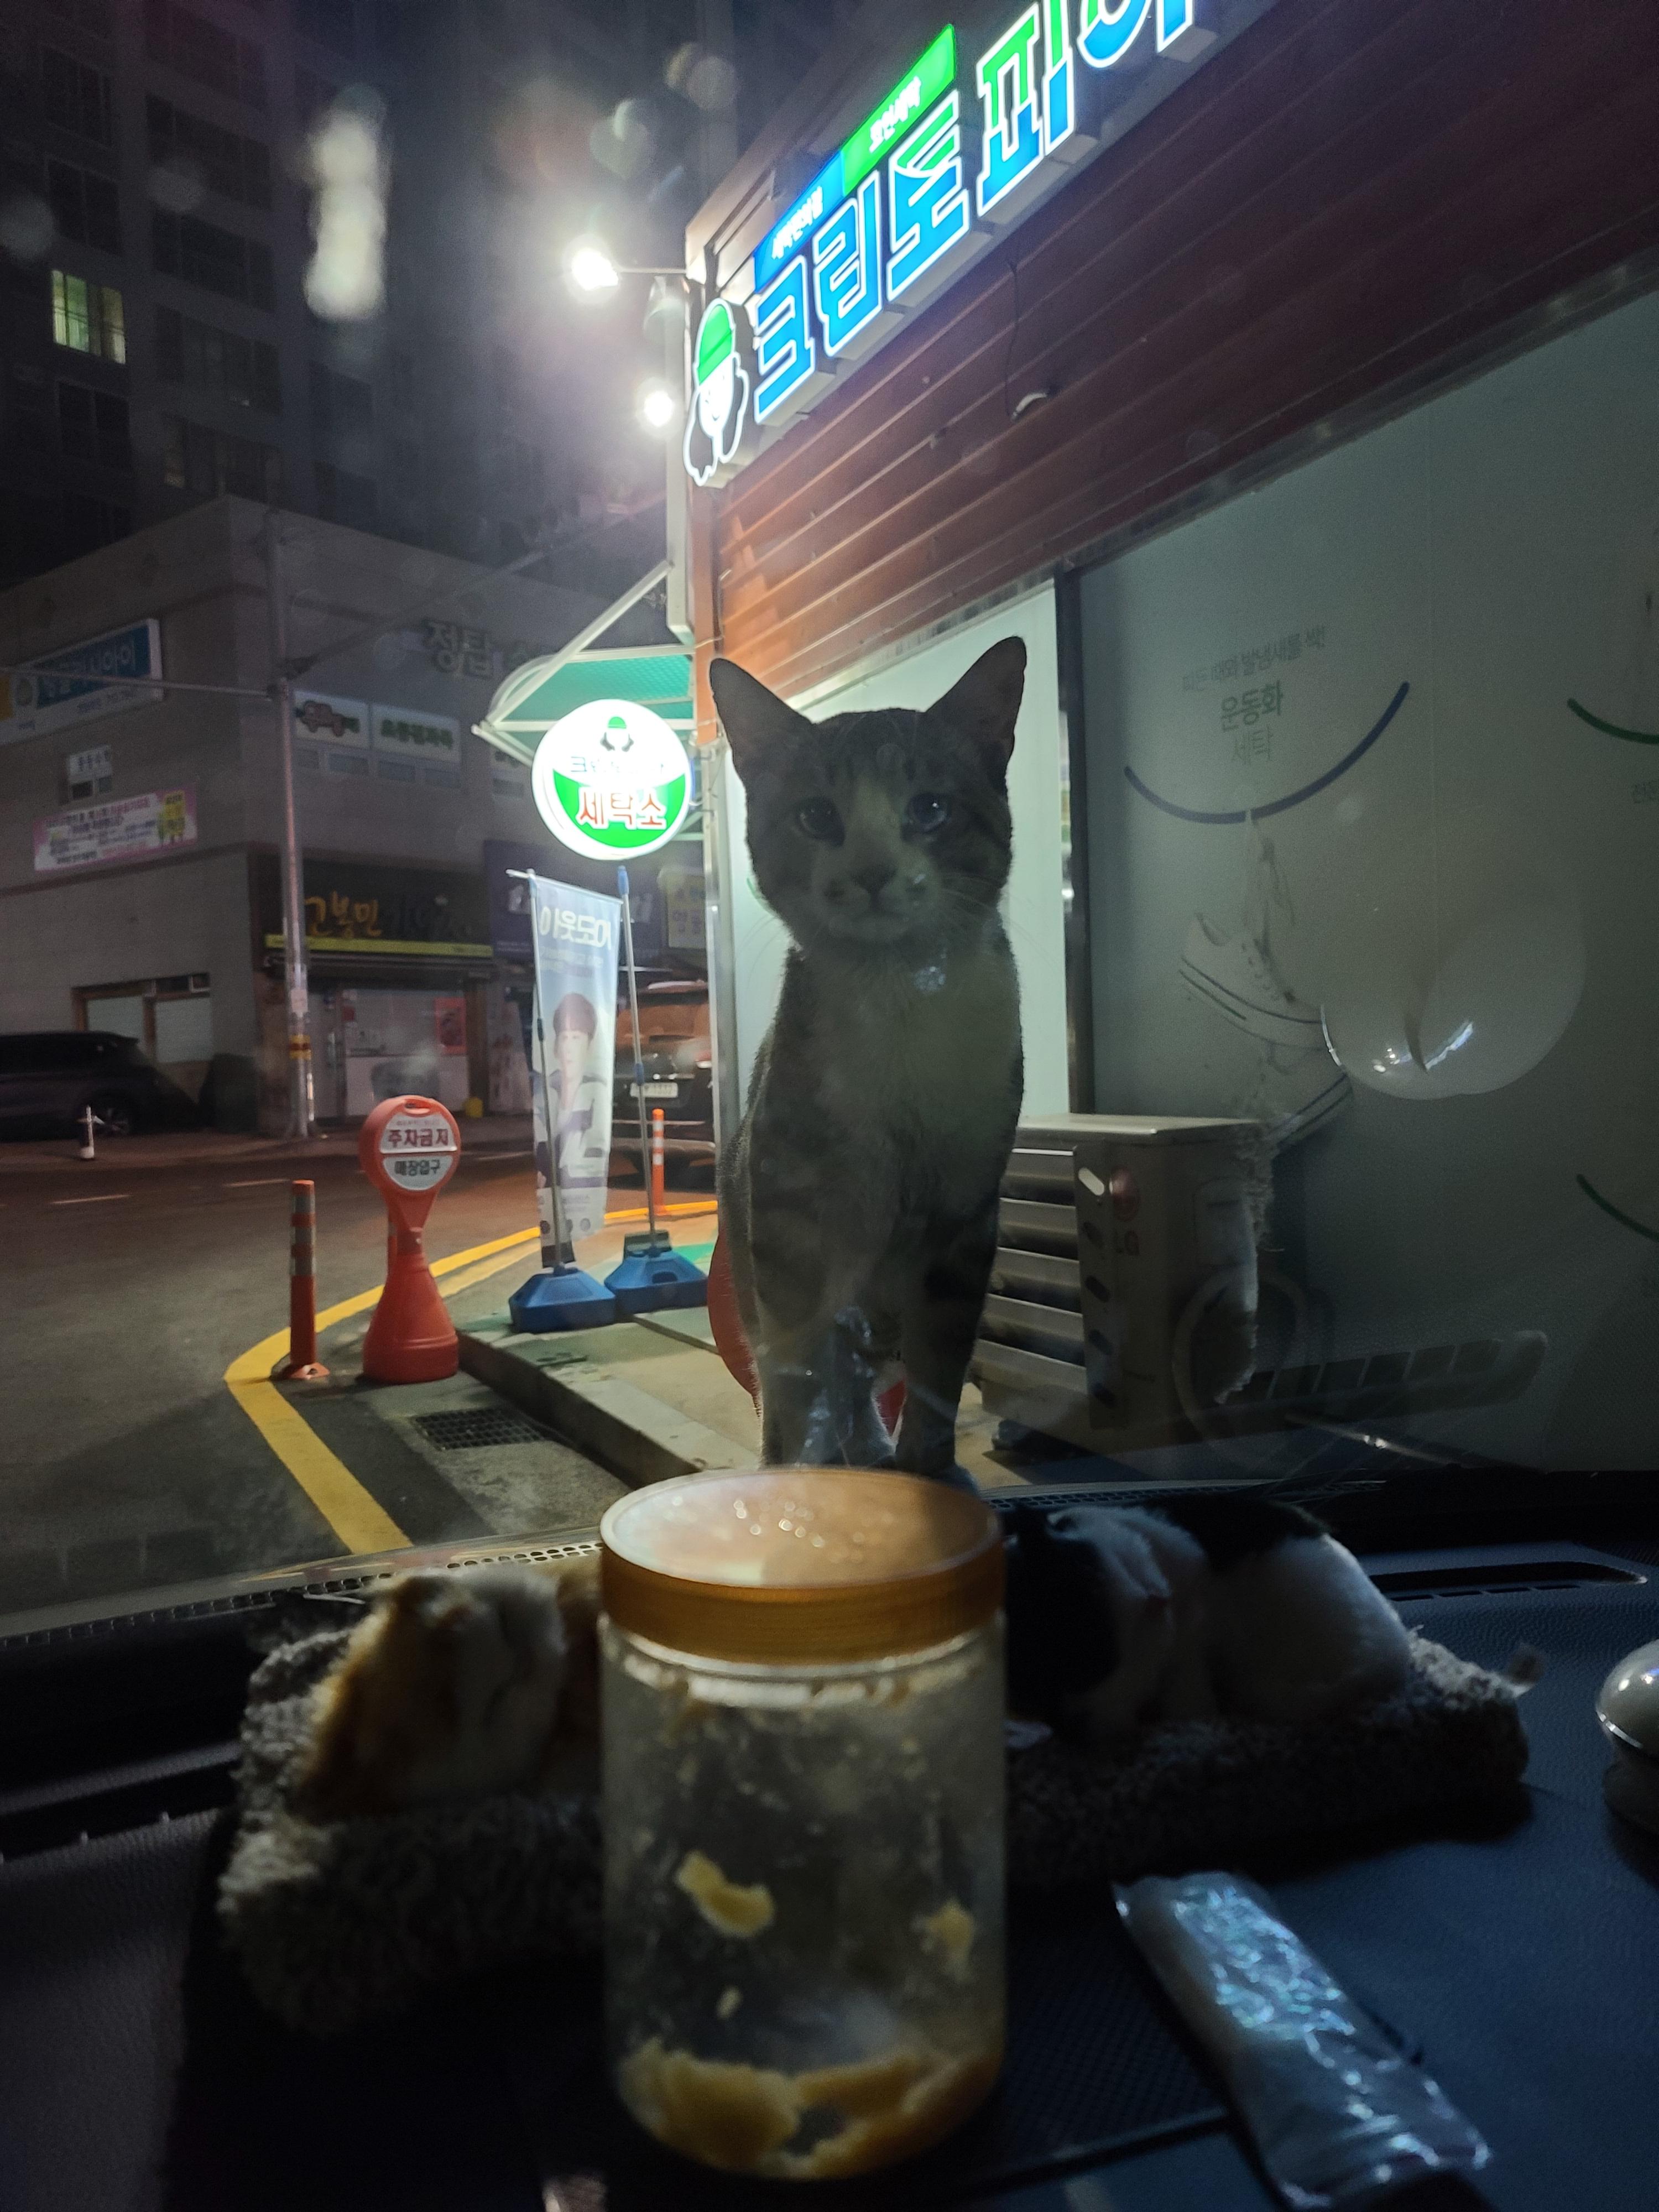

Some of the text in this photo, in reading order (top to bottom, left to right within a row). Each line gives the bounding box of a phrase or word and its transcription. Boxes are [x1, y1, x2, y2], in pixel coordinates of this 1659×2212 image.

[1220, 680, 1284, 733] 운동화
[1231, 724, 1274, 766] 세탁
[578, 789, 665, 826] 세탁소
[540, 906, 612, 950] 아웃도어
[388, 1128, 449, 1147] 주차금지
[394, 1159, 440, 1176] 매장입구
